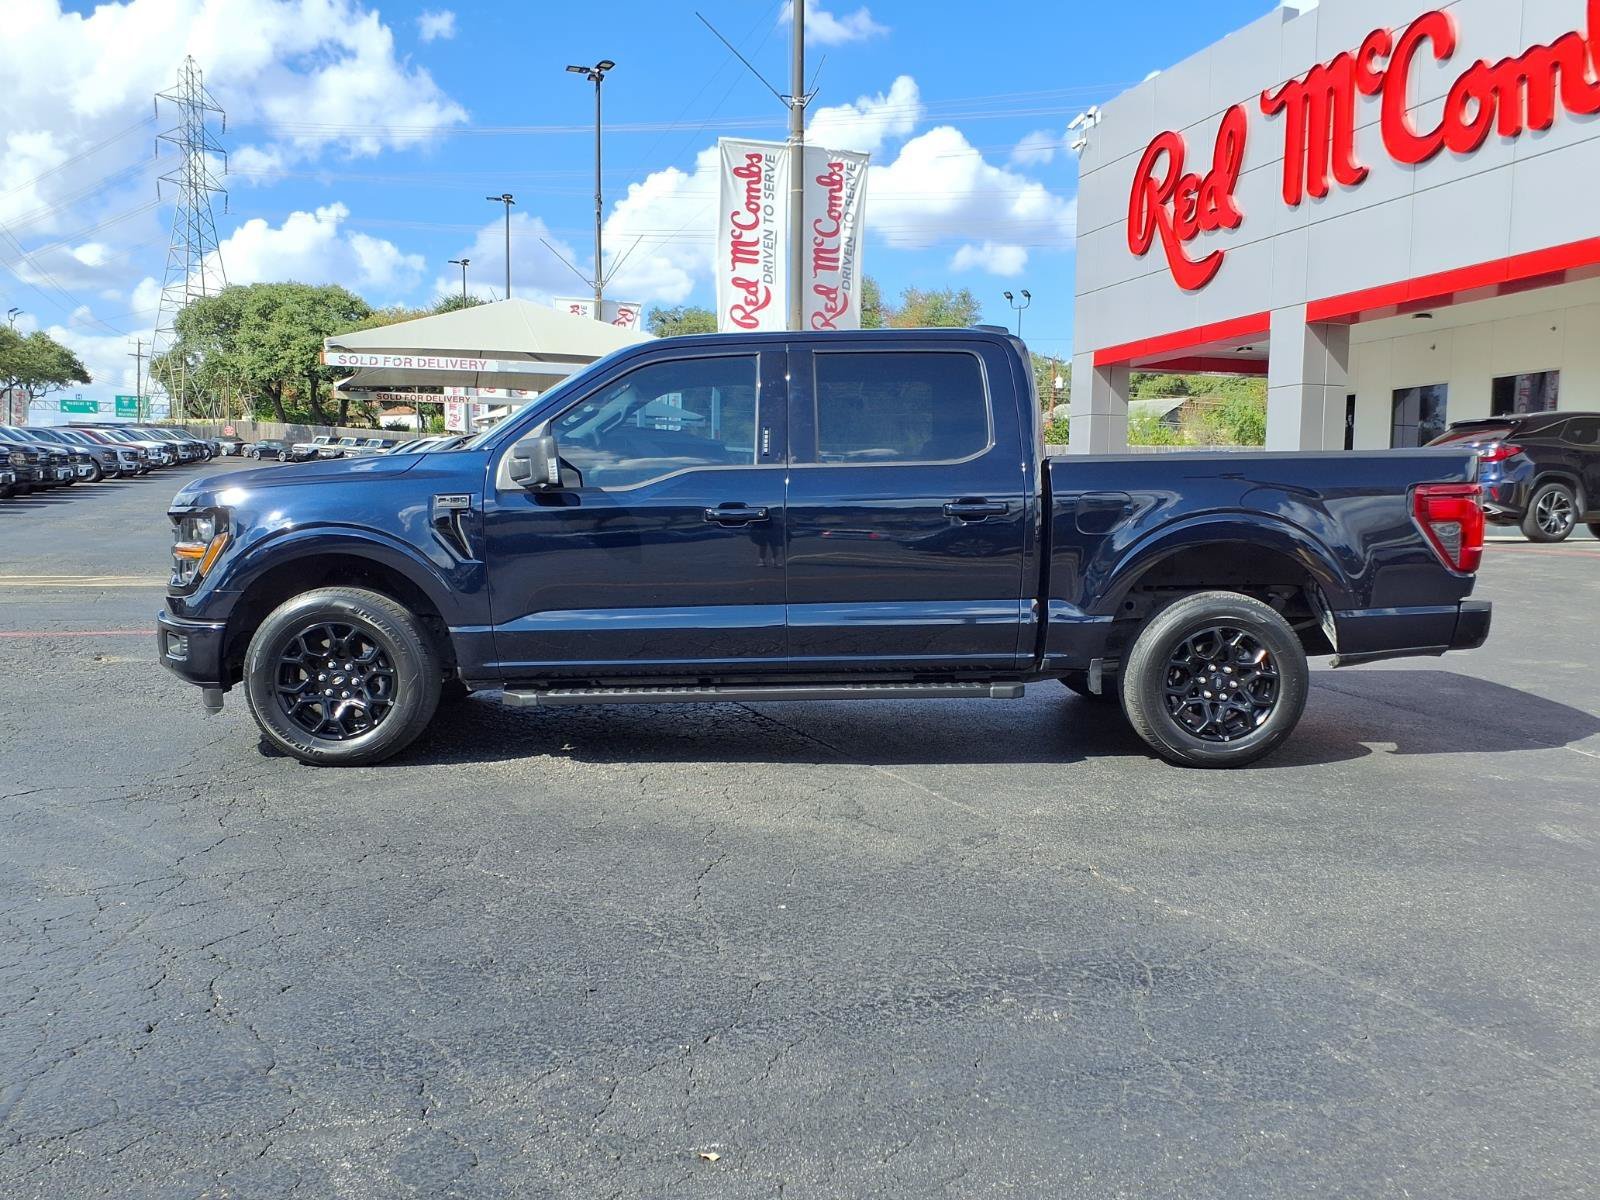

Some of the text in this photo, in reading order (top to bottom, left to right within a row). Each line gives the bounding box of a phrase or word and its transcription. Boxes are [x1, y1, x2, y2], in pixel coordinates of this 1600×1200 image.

[1127, 0, 1600, 291] Red McCom
[729, 153, 772, 330] Red McCombs
[763, 154, 776, 285] DRIVEN TO SERVE
[811, 161, 849, 330] Red McCombs
[842, 162, 857, 291] DRIVEN TO SERVE
[338, 354, 488, 371] SOLD FOR DELIVERY
[376, 392, 471, 403] SOLD FOR DELIVERY
